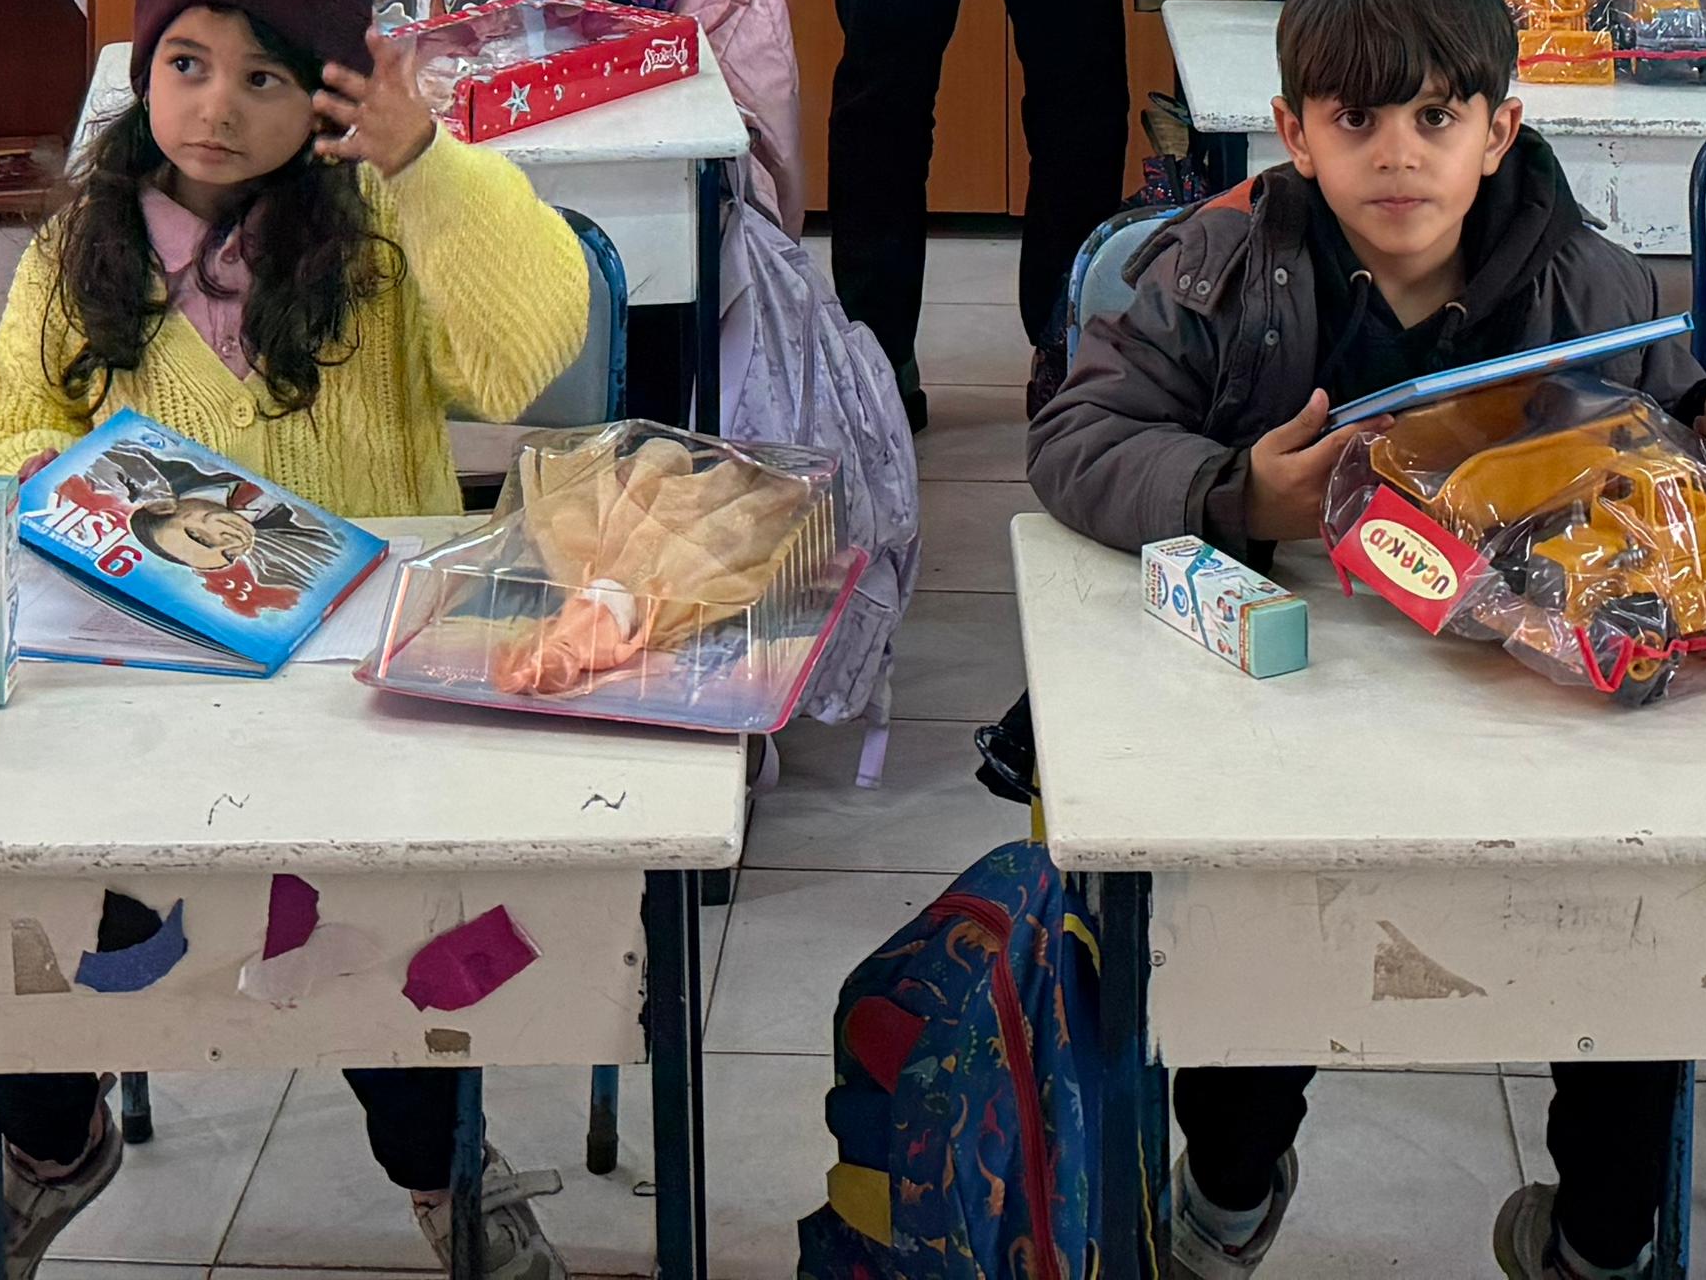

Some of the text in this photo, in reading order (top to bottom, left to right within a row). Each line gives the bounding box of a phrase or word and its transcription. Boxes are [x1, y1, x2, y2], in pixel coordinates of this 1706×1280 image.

[19, 491, 130, 555] IŞIK
[94, 543, 143, 578] 9
[1368, 526, 1451, 595] UCARKID
